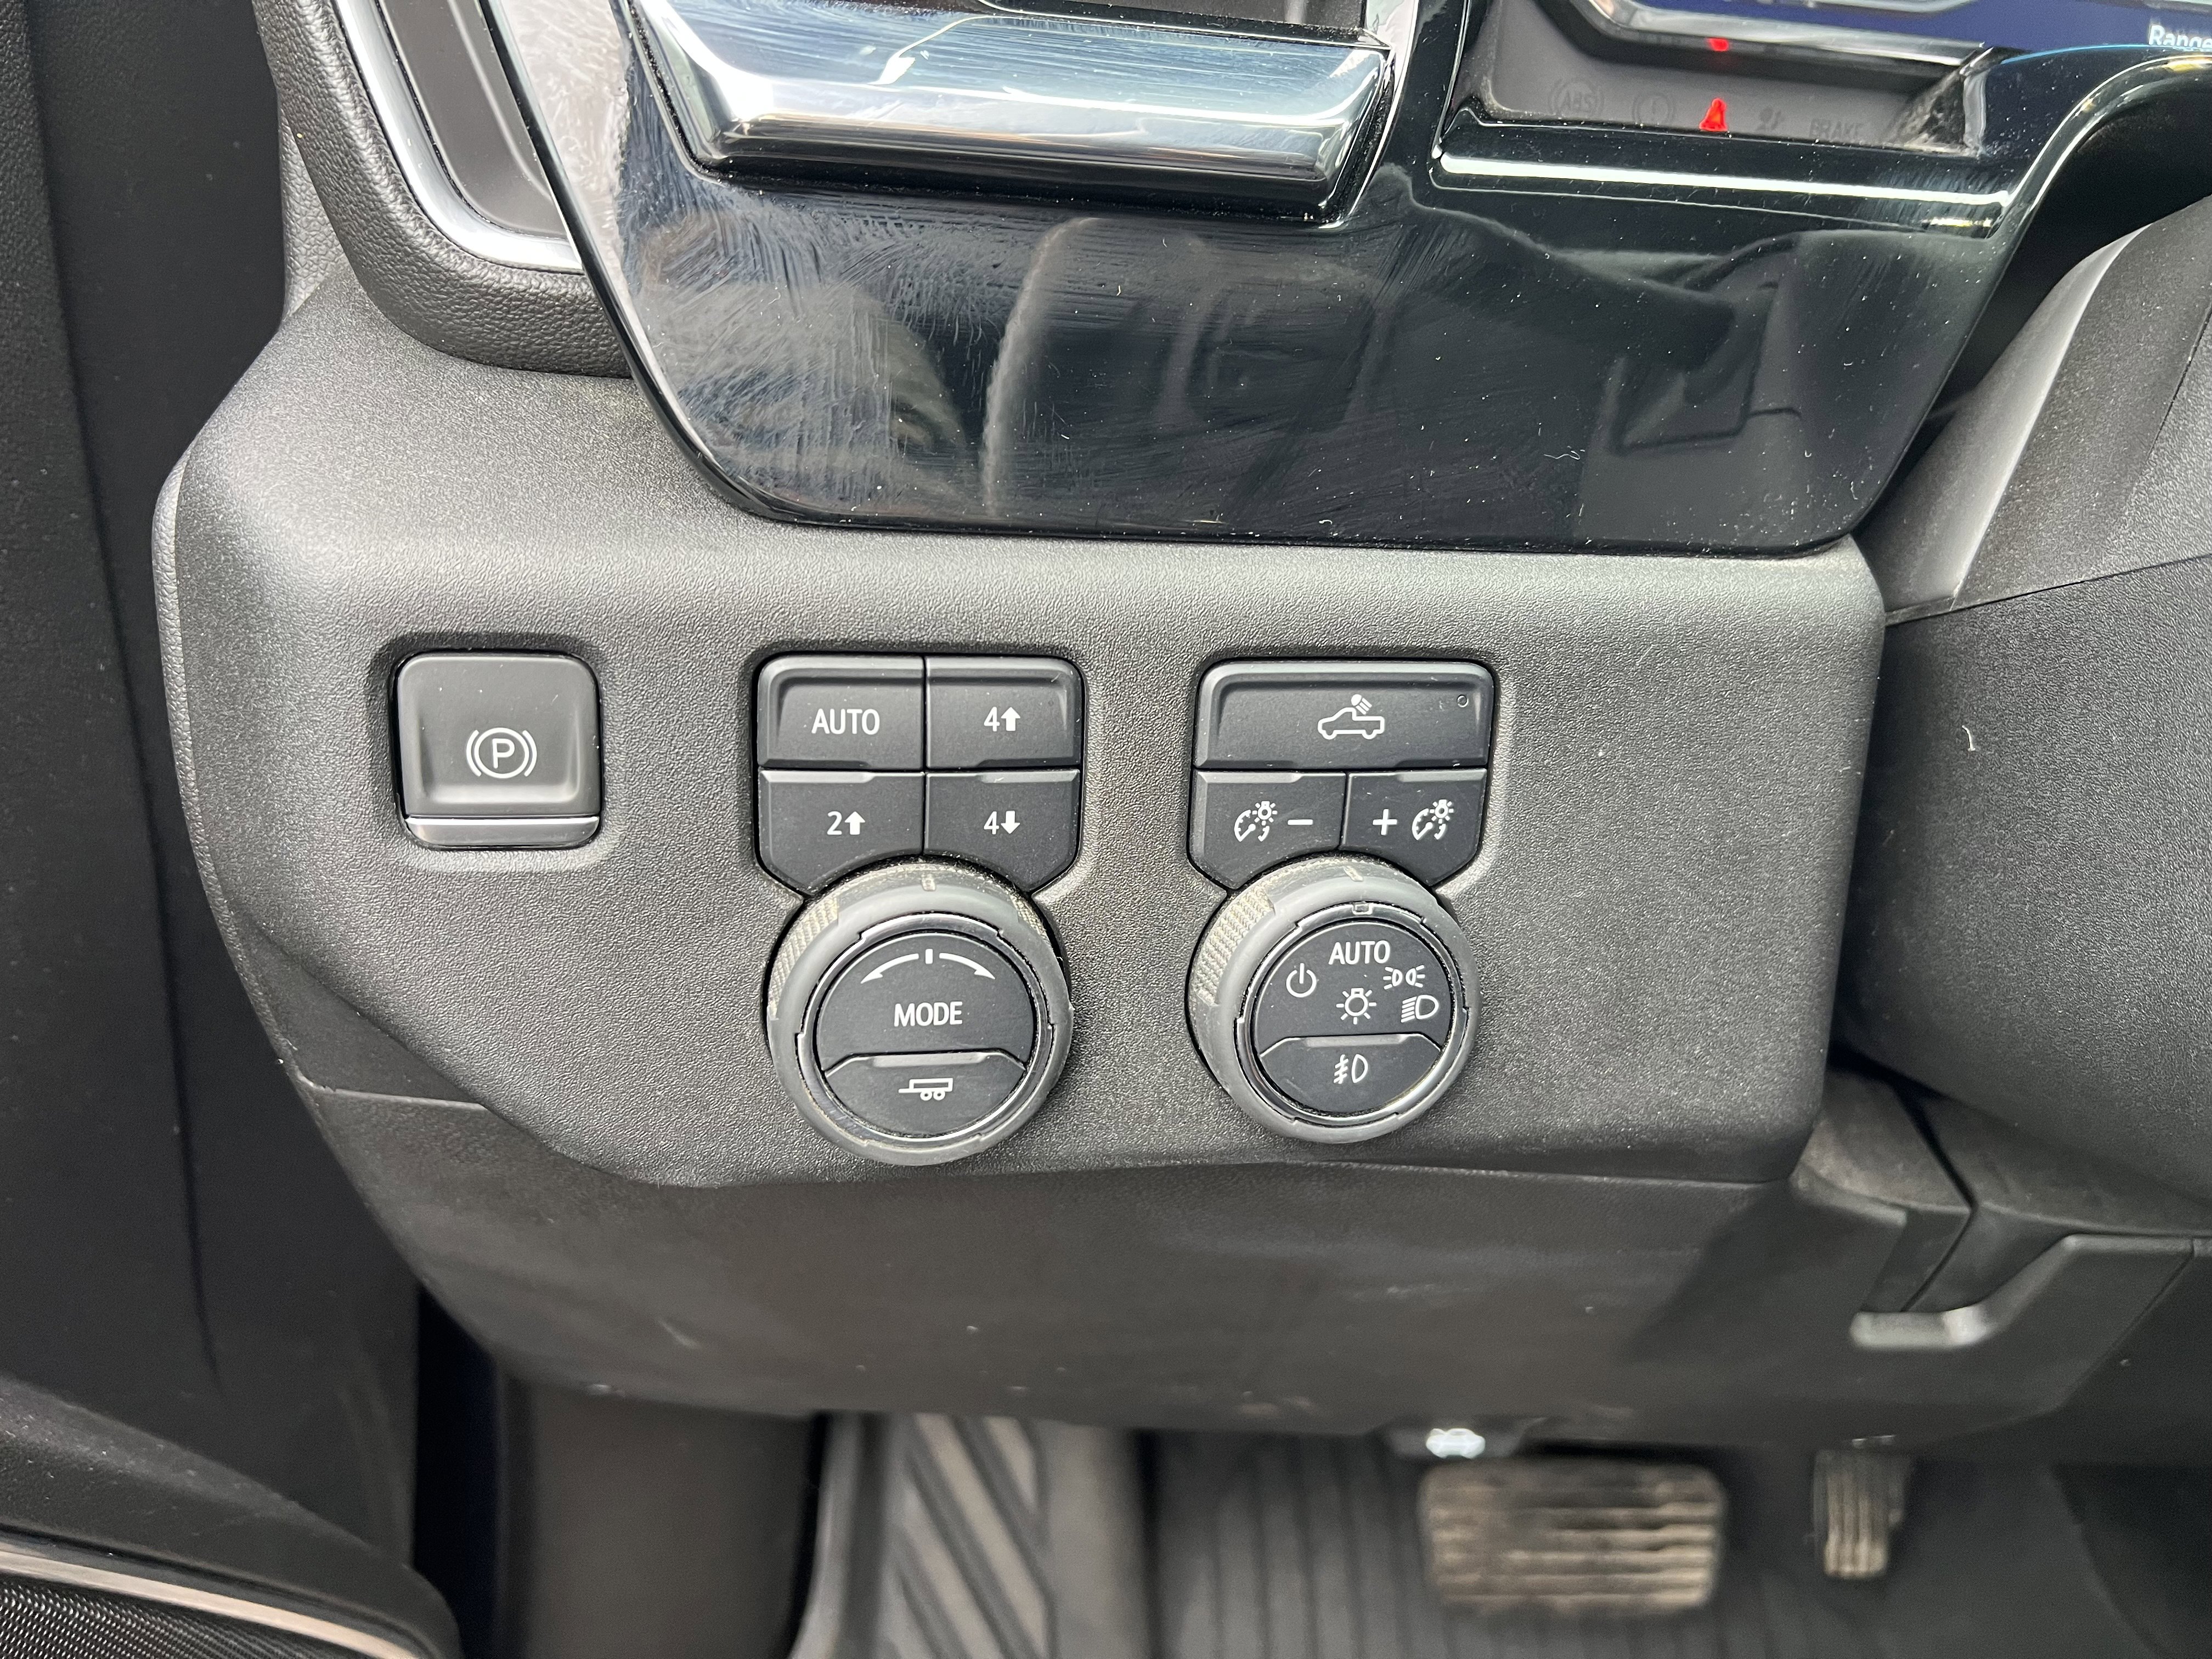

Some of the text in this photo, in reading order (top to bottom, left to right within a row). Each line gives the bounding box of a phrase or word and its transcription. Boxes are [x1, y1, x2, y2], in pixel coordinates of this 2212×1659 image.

[1560, 92, 1595, 112] ABS
[1809, 118, 1865, 138] BRAKE
[811, 708, 881, 735] AUTO
[983, 706, 1000, 732] 4
[492, 738, 515, 769] P
[826, 811, 843, 836] 2
[983, 811, 1000, 836] 4
[1328, 940, 1391, 966] AUTO
[894, 1001, 963, 1028] MODE
